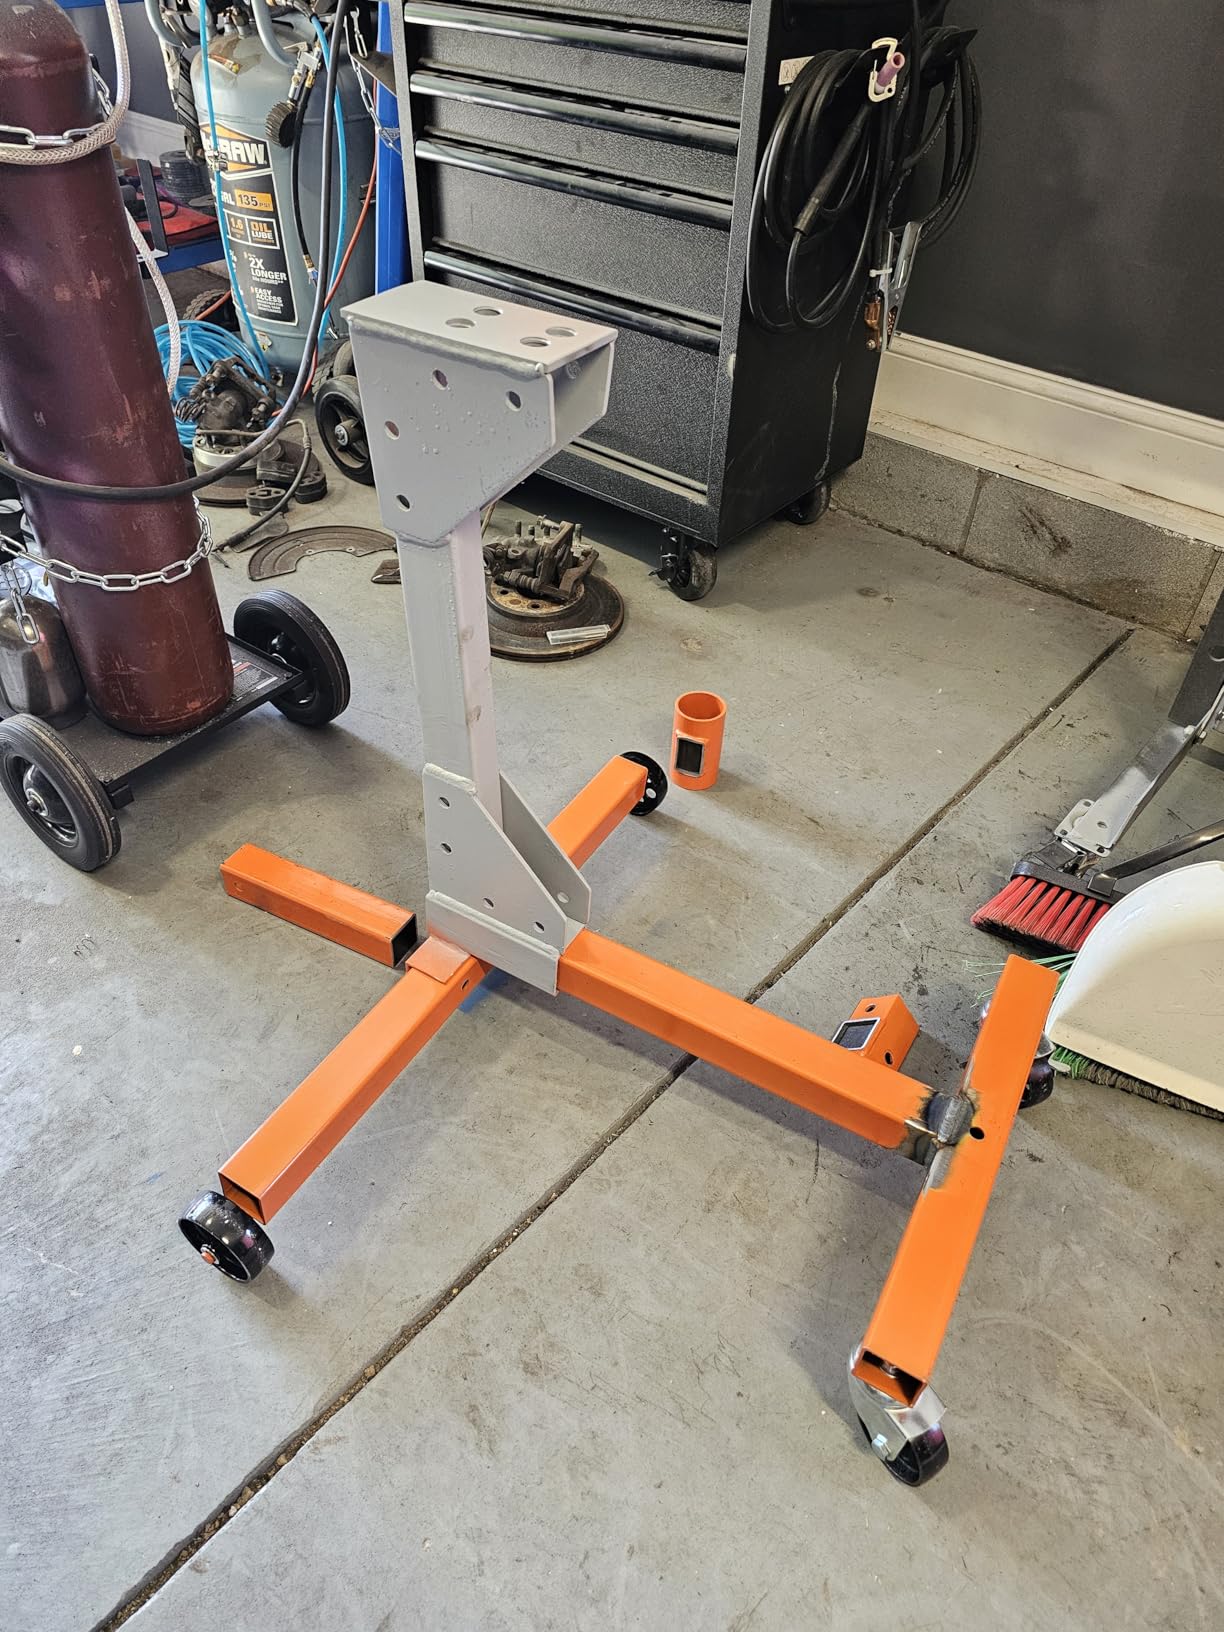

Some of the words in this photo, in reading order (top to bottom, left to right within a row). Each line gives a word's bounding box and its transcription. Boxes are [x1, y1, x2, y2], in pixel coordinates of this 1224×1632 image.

[238, 194, 258, 207] 135
[230, 217, 244, 230] 1.6
[250, 221, 273, 233] OIL
[251, 230, 274, 240] LUBE
[249, 257, 265, 270] 2X
[250, 268, 287, 281] LONGER
[254, 287, 272, 296] EASY
[255, 293, 283, 303] ACCESS
